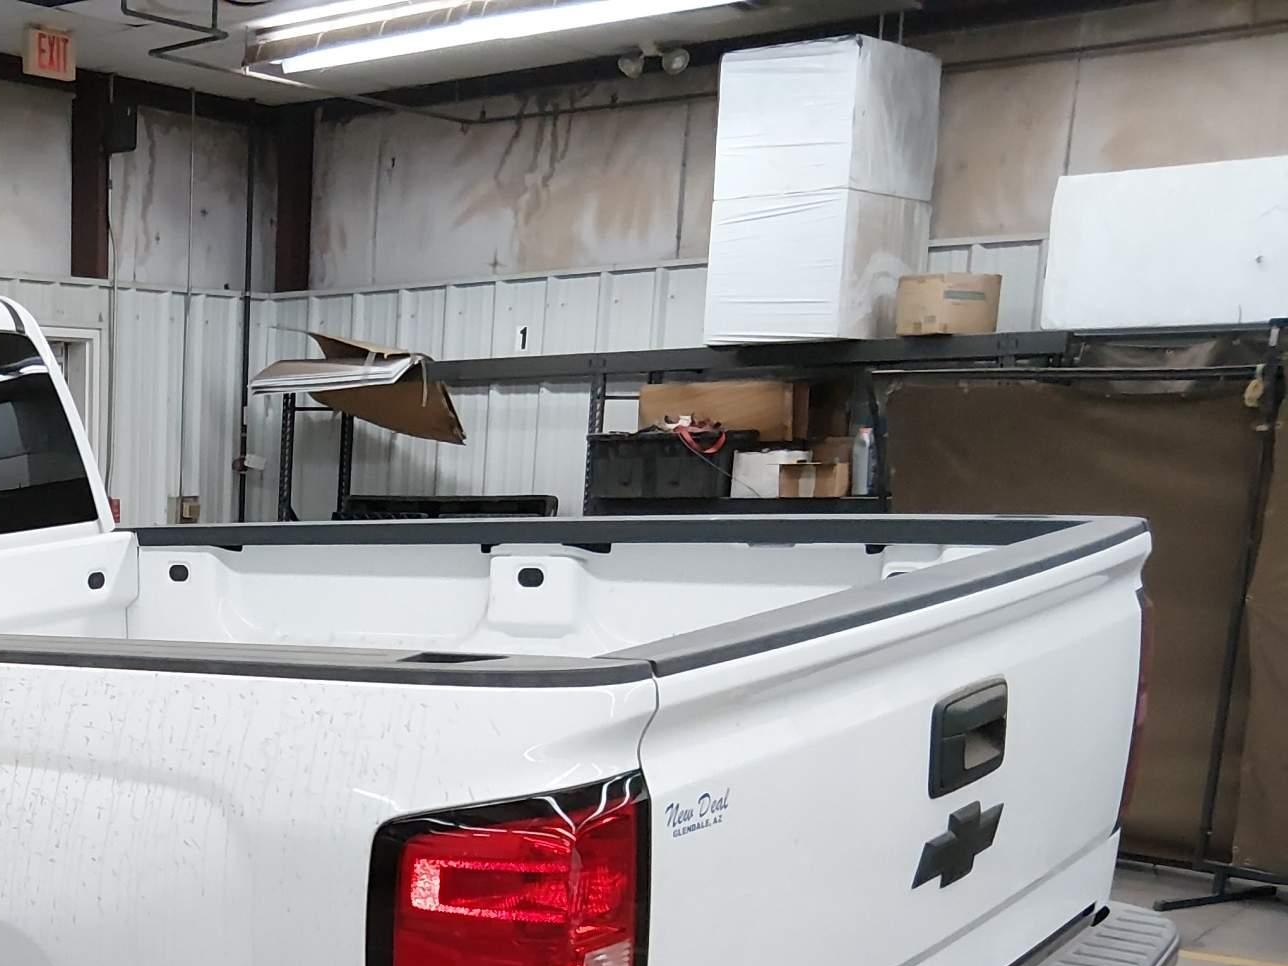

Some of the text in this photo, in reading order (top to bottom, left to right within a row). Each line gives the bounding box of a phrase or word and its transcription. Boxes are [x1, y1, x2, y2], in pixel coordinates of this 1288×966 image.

[37, 32, 69, 73] EXIT
[520, 326, 527, 350] 1
[665, 787, 730, 828] New Deal
[672, 814, 723, 838] GLENDALE, AZ
